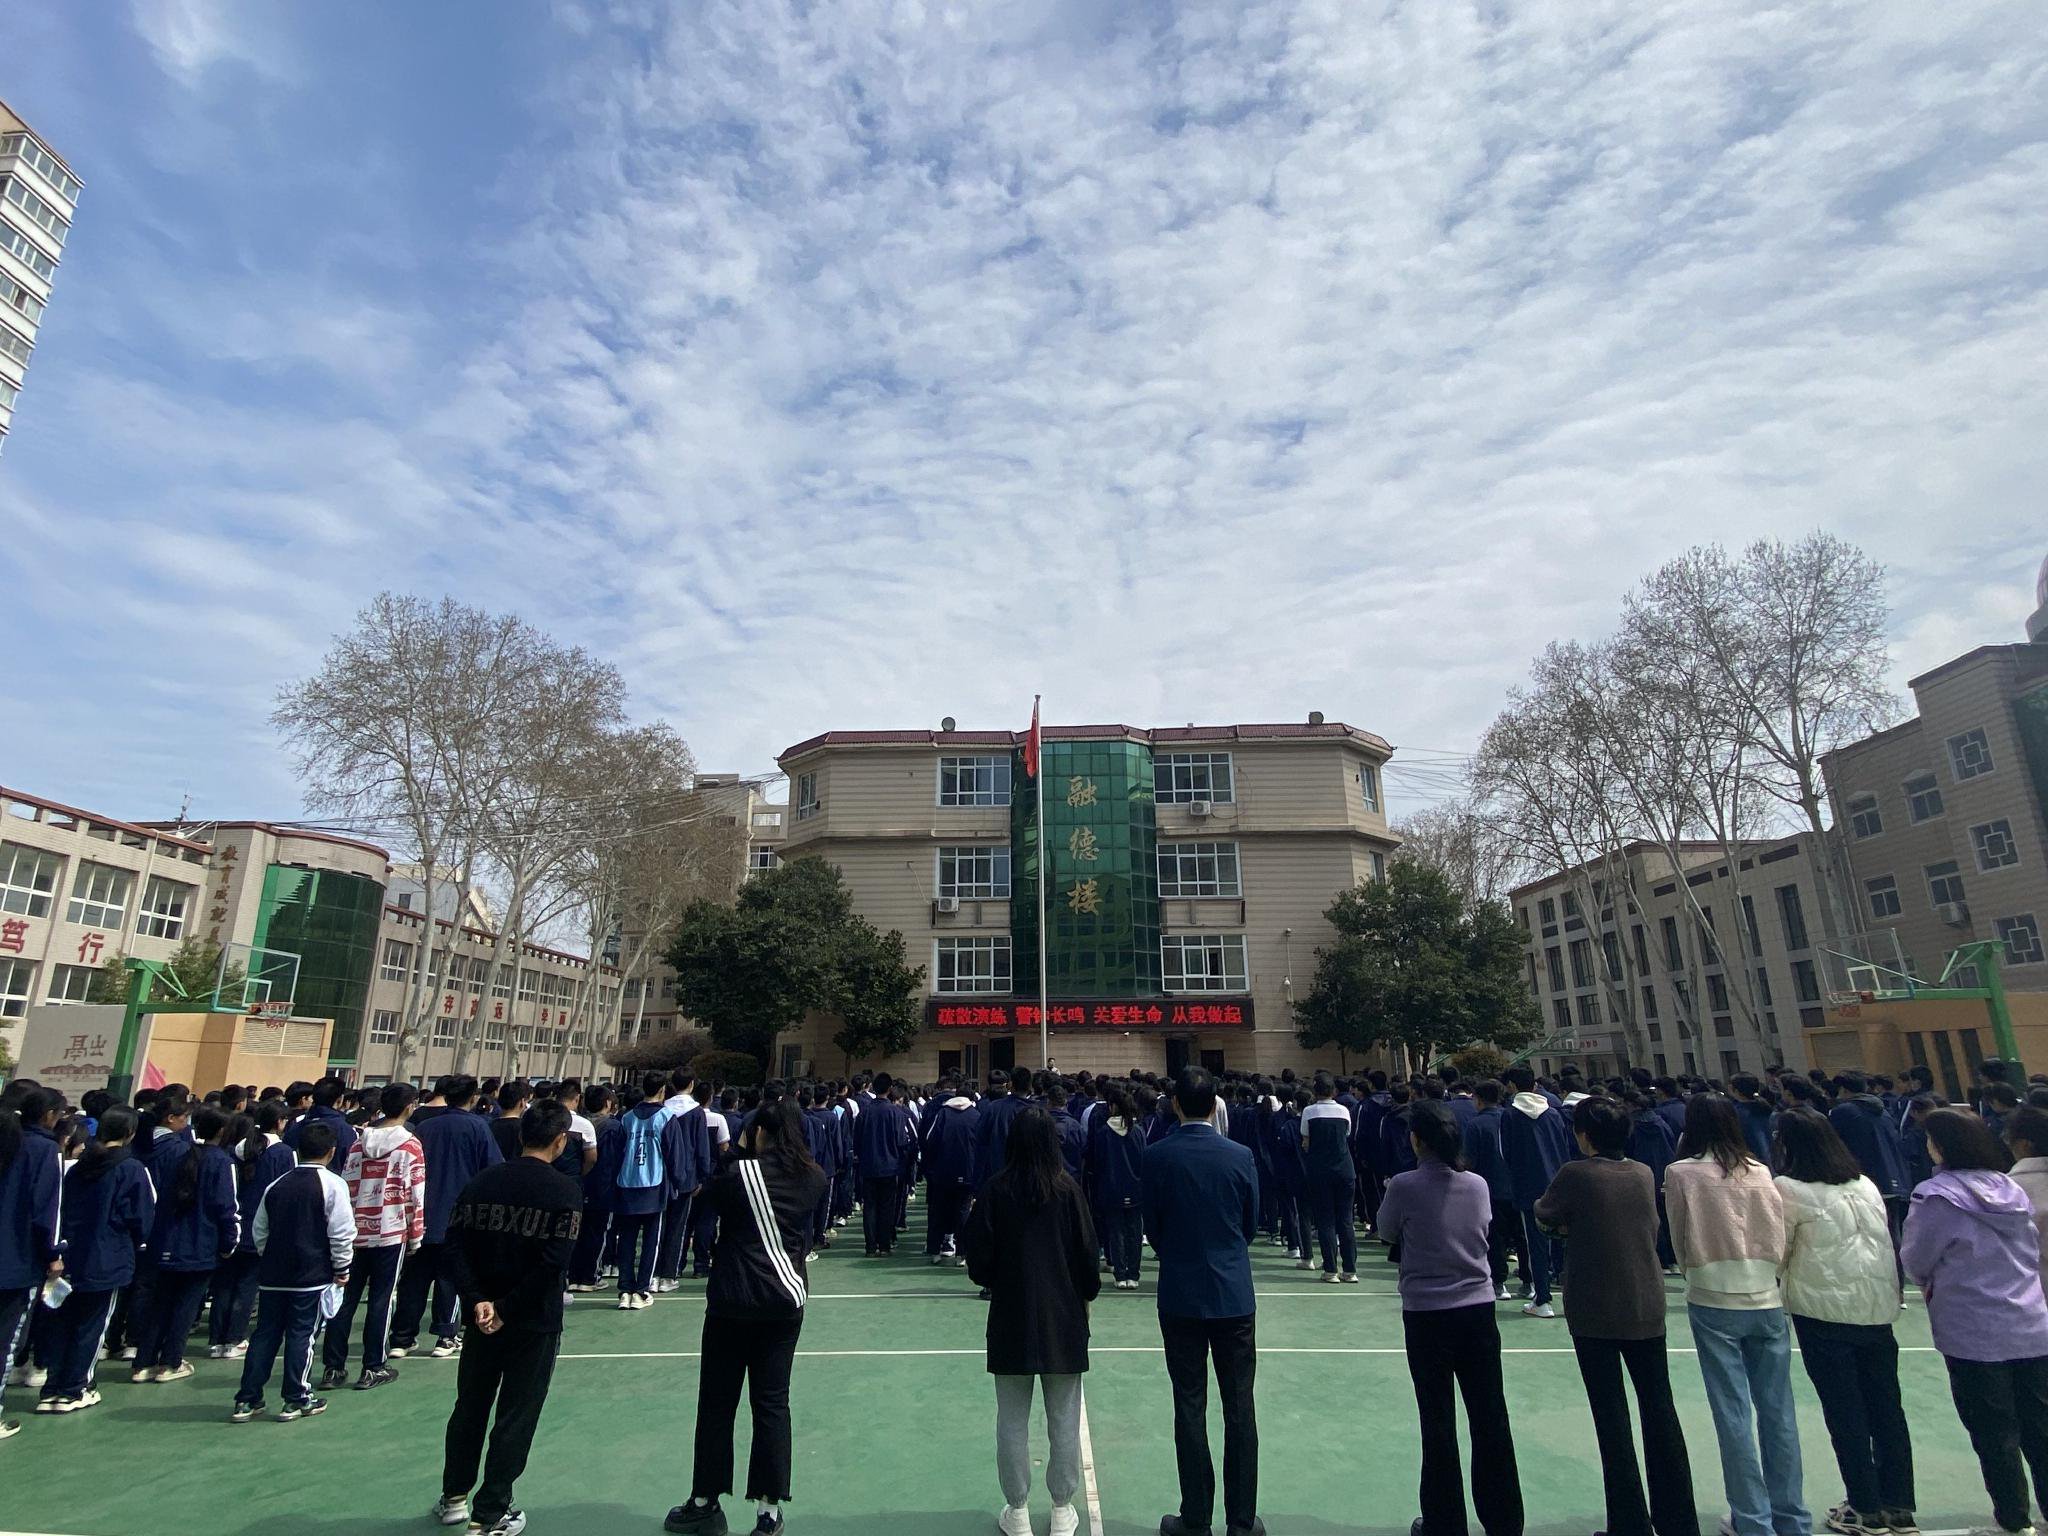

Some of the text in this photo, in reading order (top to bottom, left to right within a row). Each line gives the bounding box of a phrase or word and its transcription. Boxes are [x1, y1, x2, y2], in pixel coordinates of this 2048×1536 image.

[1066, 775, 1104, 916] 融德楼
[0, 918, 105, 963] 笃行
[937, 1004, 1243, 1025] 疏散演练 警钟长鸣 关爱生命 从我做起
[635, 1142, 648, 1166] 4
